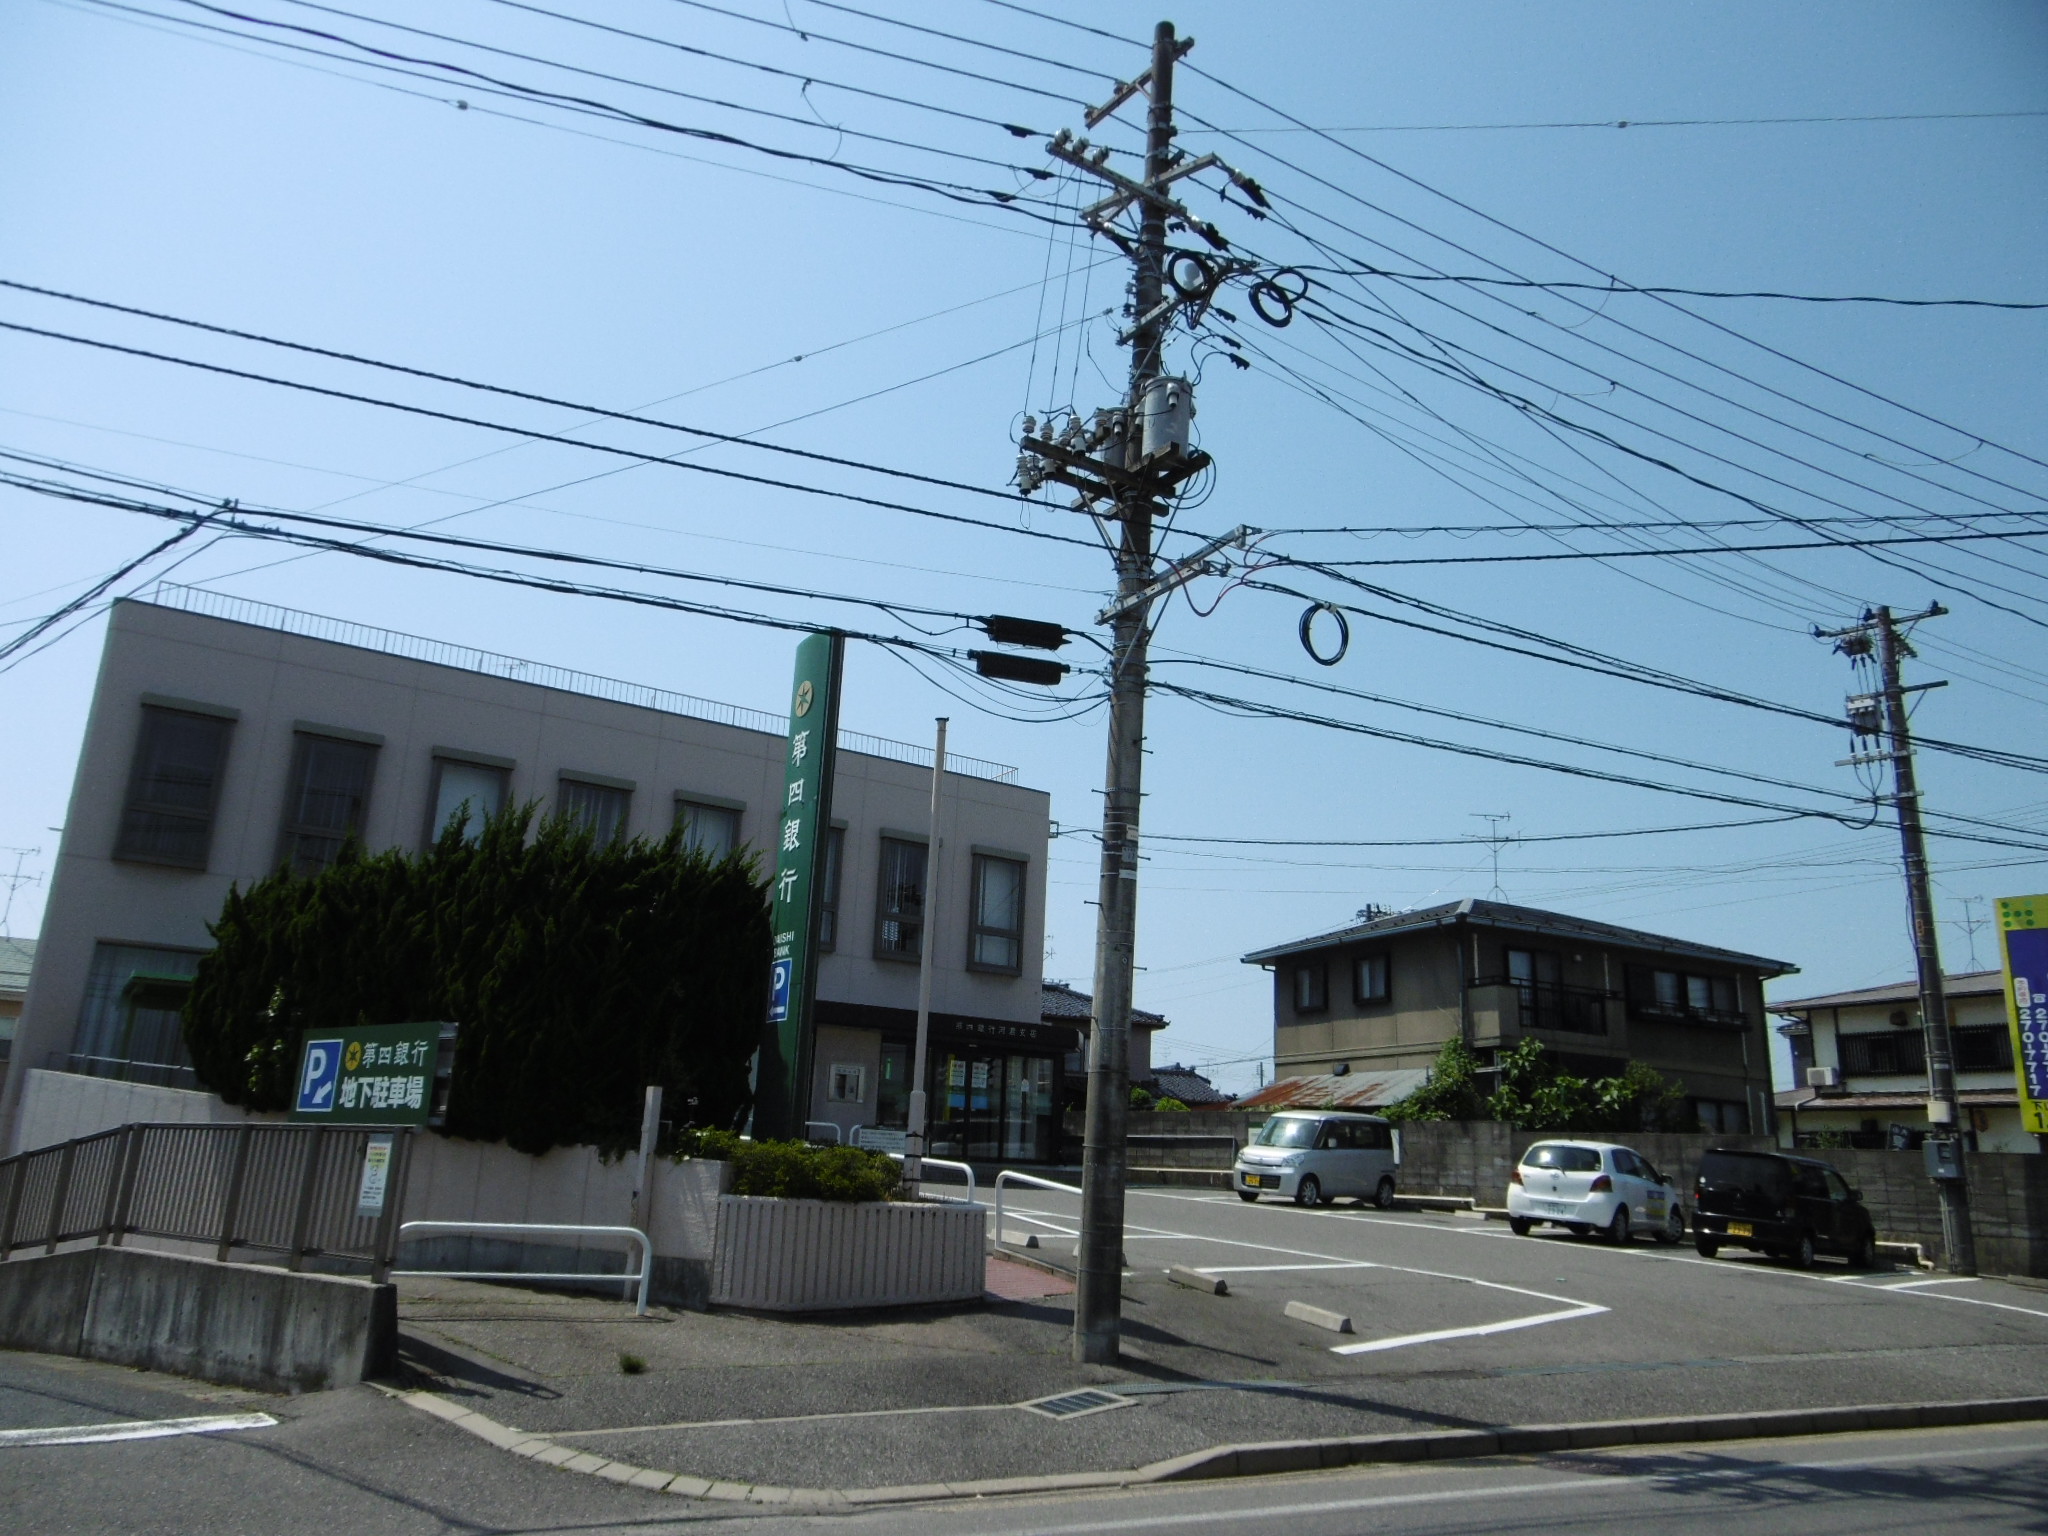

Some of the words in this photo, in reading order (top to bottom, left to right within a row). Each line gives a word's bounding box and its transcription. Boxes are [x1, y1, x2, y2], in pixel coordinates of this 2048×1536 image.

[778, 730, 810, 903] 第四銀行
[772, 966, 786, 1001] P
[304, 1049, 327, 1094] P
[362, 1040, 428, 1068] 第四銀行
[339, 1076, 424, 1108] 地下駐車場
